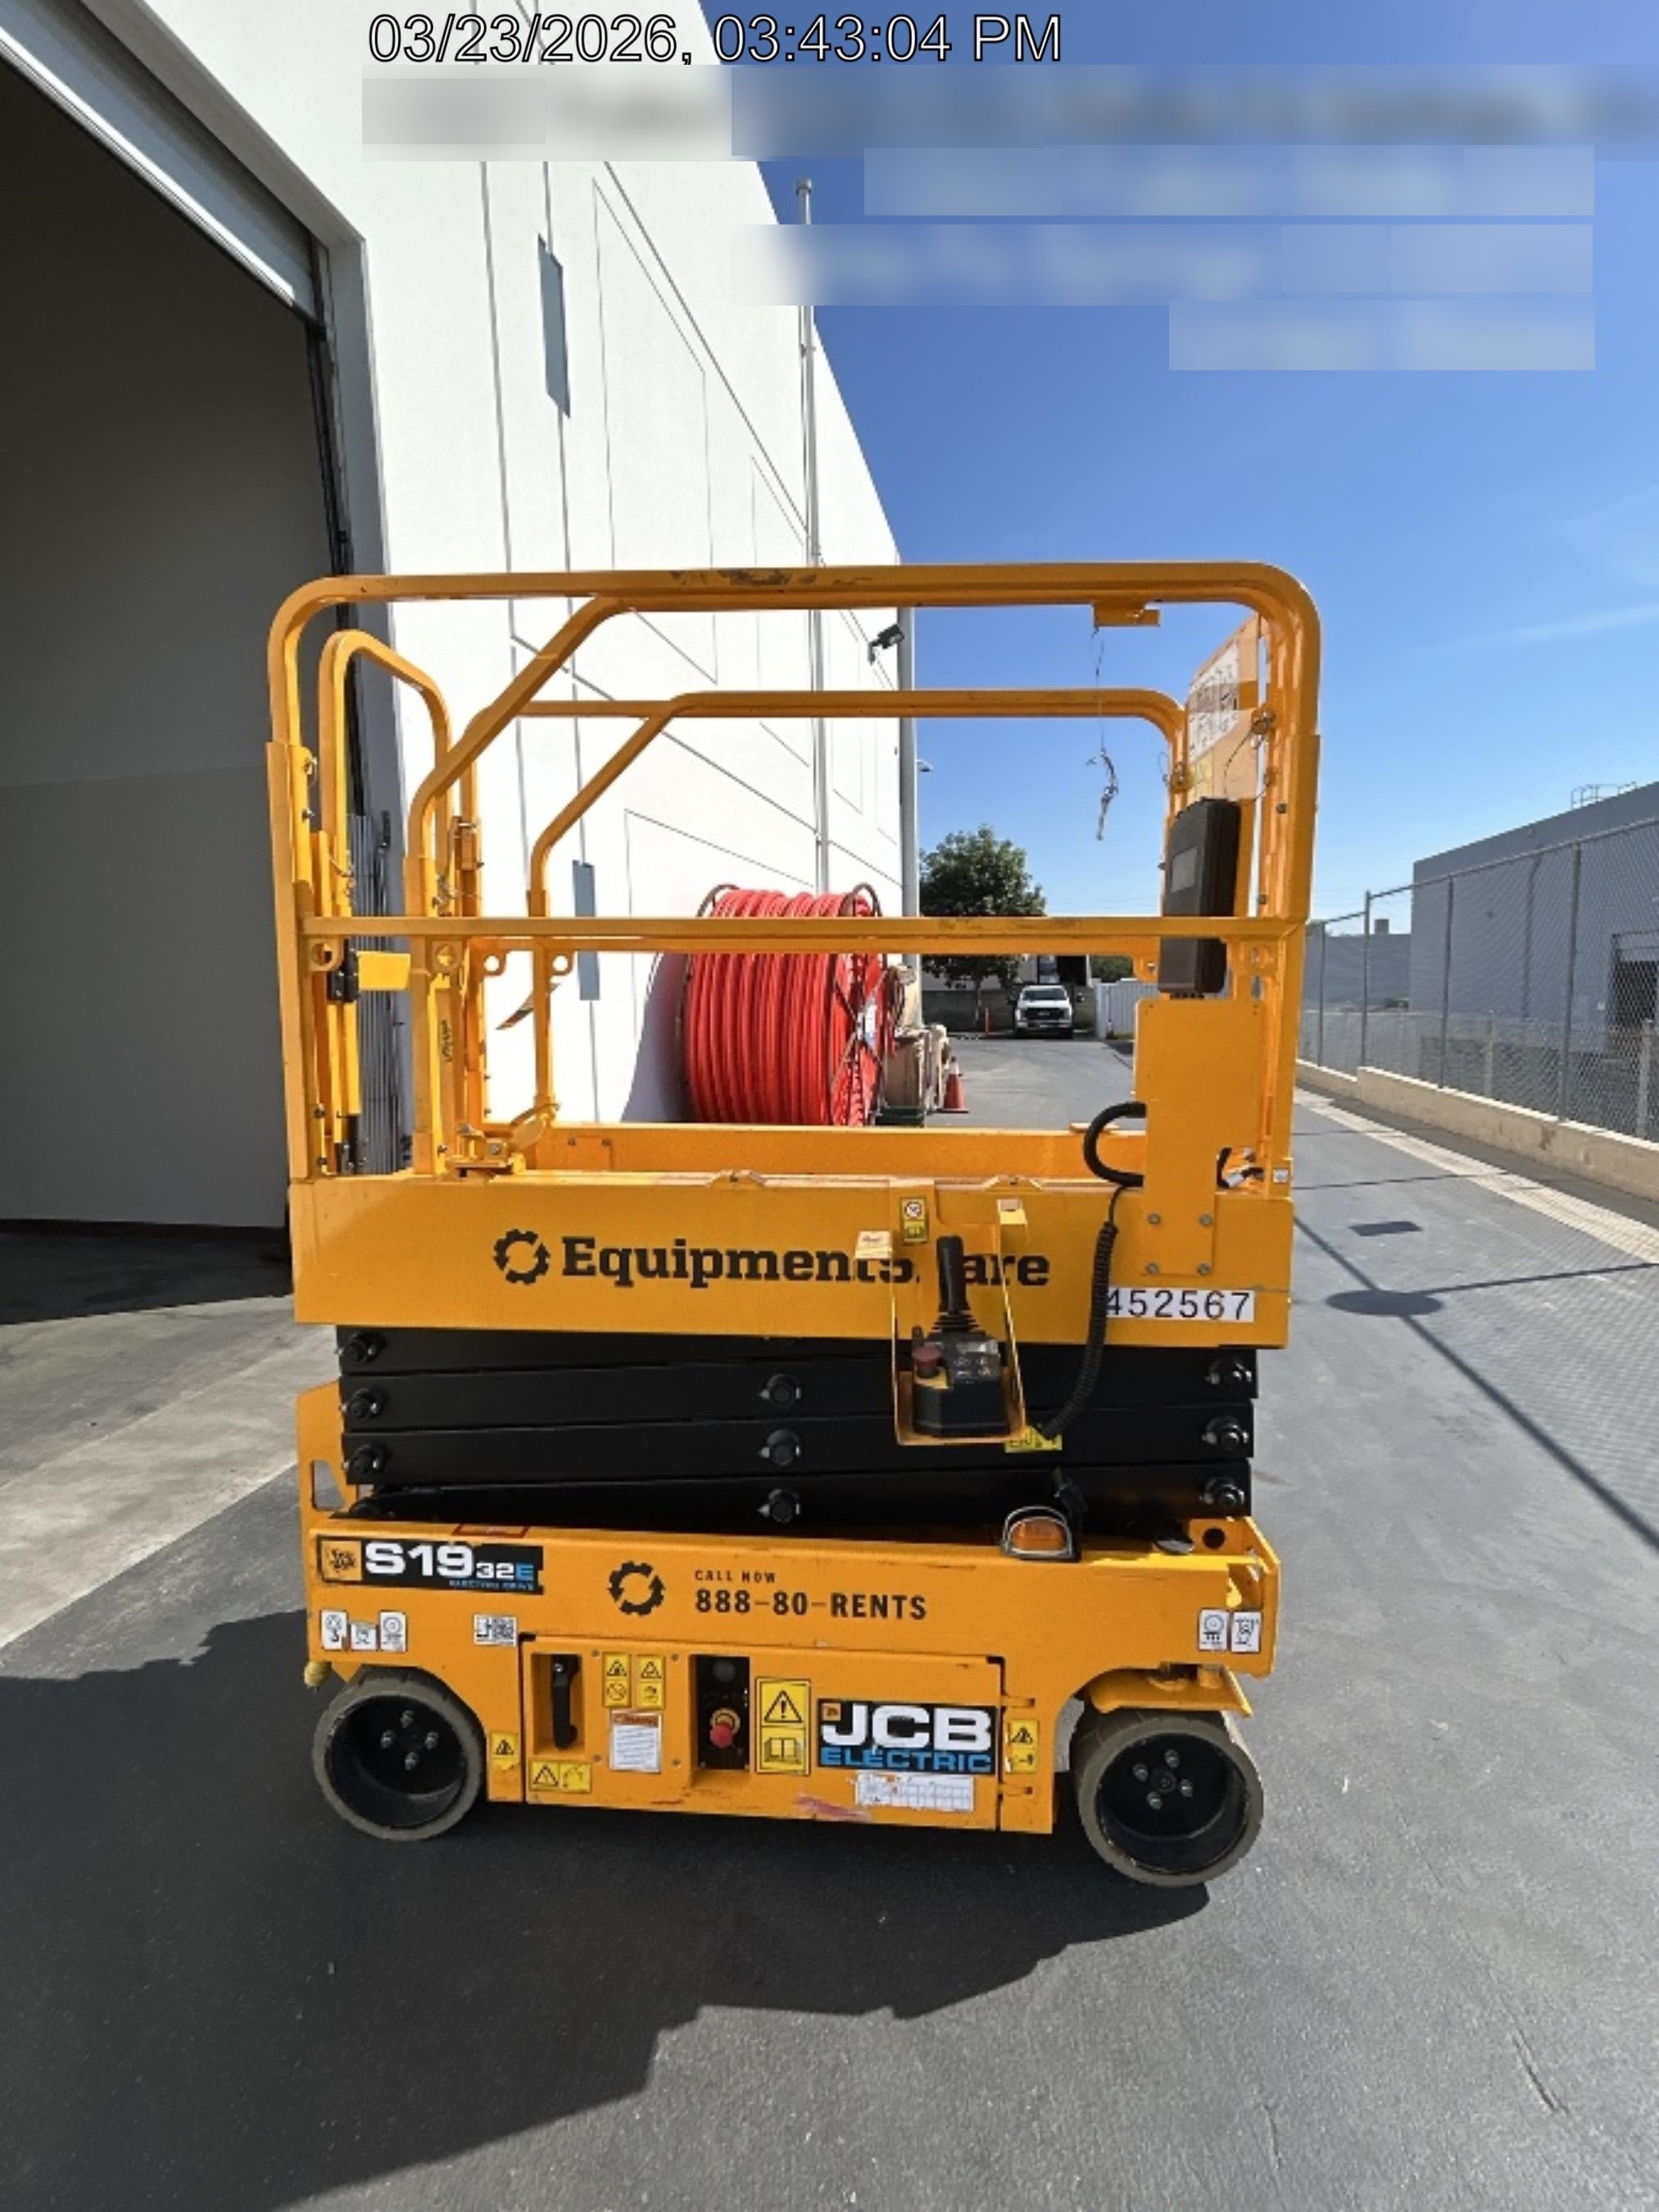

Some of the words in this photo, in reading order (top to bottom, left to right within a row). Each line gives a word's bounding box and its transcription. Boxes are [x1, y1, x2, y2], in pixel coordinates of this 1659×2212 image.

[1107, 1289, 1250, 1320] 452567
[365, 1542, 474, 1578] S19
[476, 1562, 533, 1580] 32E
[695, 1569, 733, 1582] CALL
[741, 1571, 776, 1584] NOW
[696, 1589, 927, 1620] 888-80-RENTS
[820, 1703, 992, 1752] JCB
[821, 1746, 991, 1773] ELECTRIC
